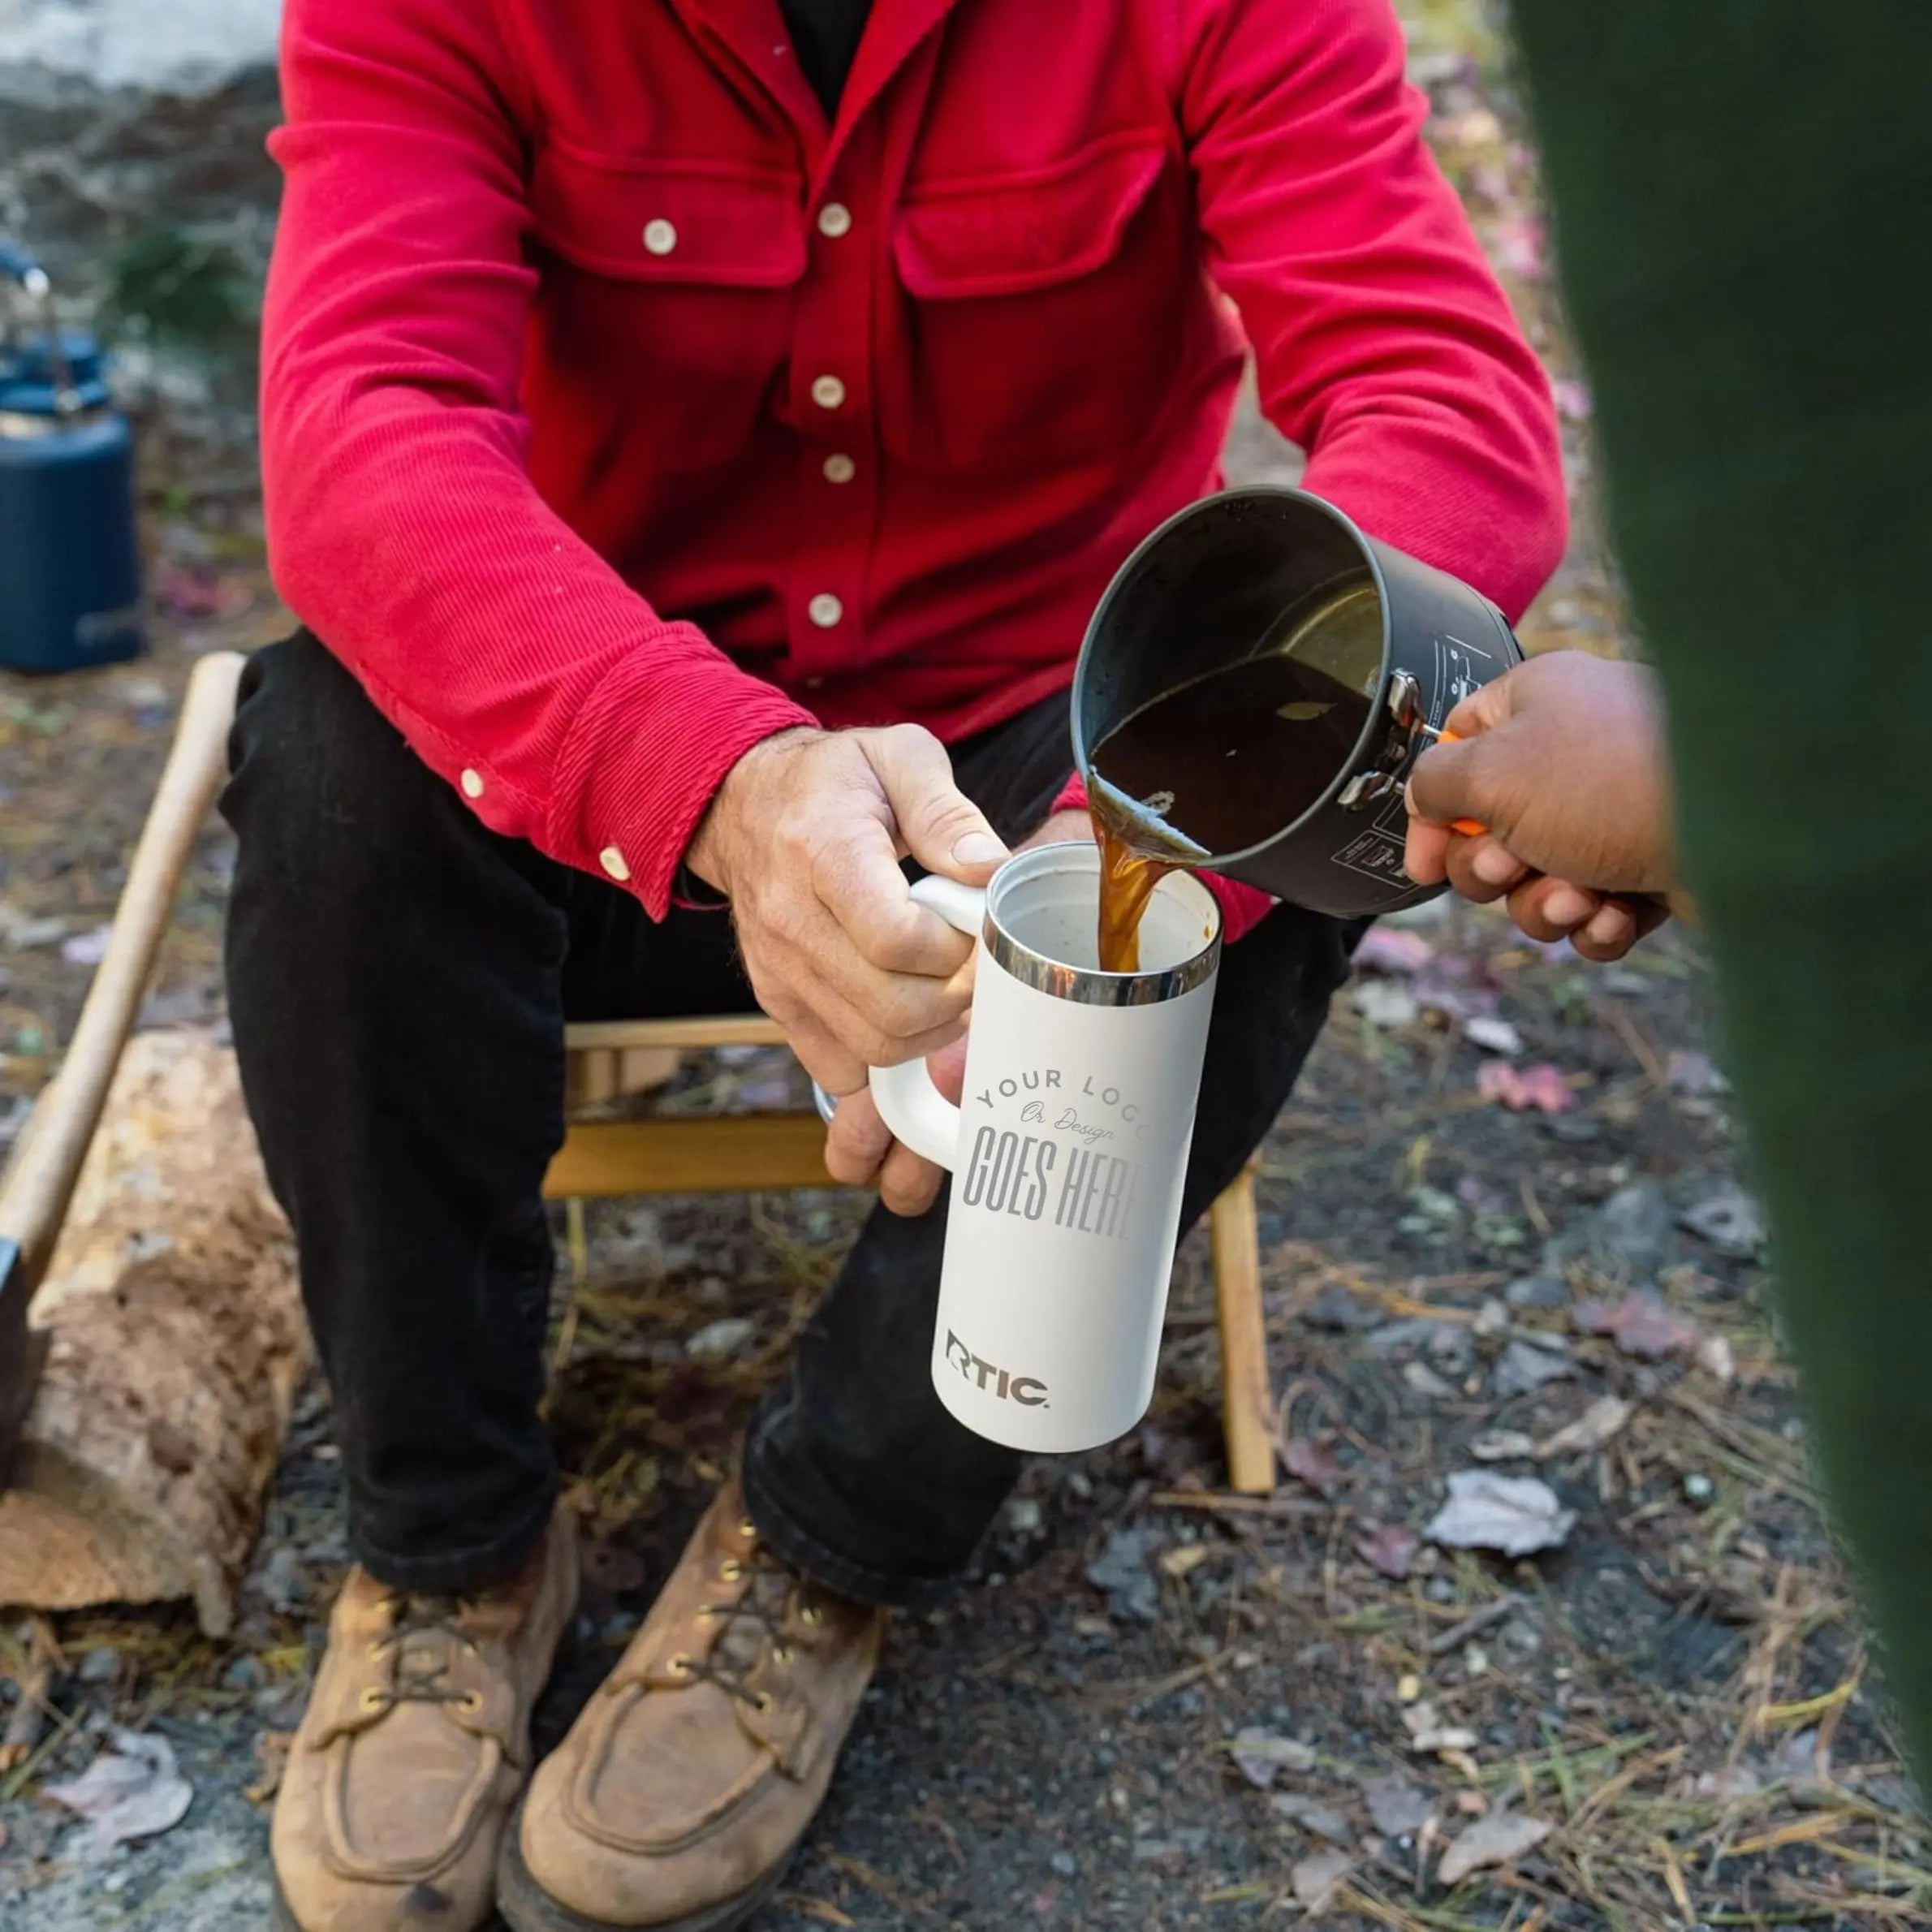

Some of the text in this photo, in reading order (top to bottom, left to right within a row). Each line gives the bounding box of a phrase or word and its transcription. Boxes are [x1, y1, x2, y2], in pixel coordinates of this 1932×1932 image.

[976, 1069, 1062, 1109] YOUR
[1020, 1101, 1115, 1145] Or Design
[963, 1125, 1057, 1221] GOES
